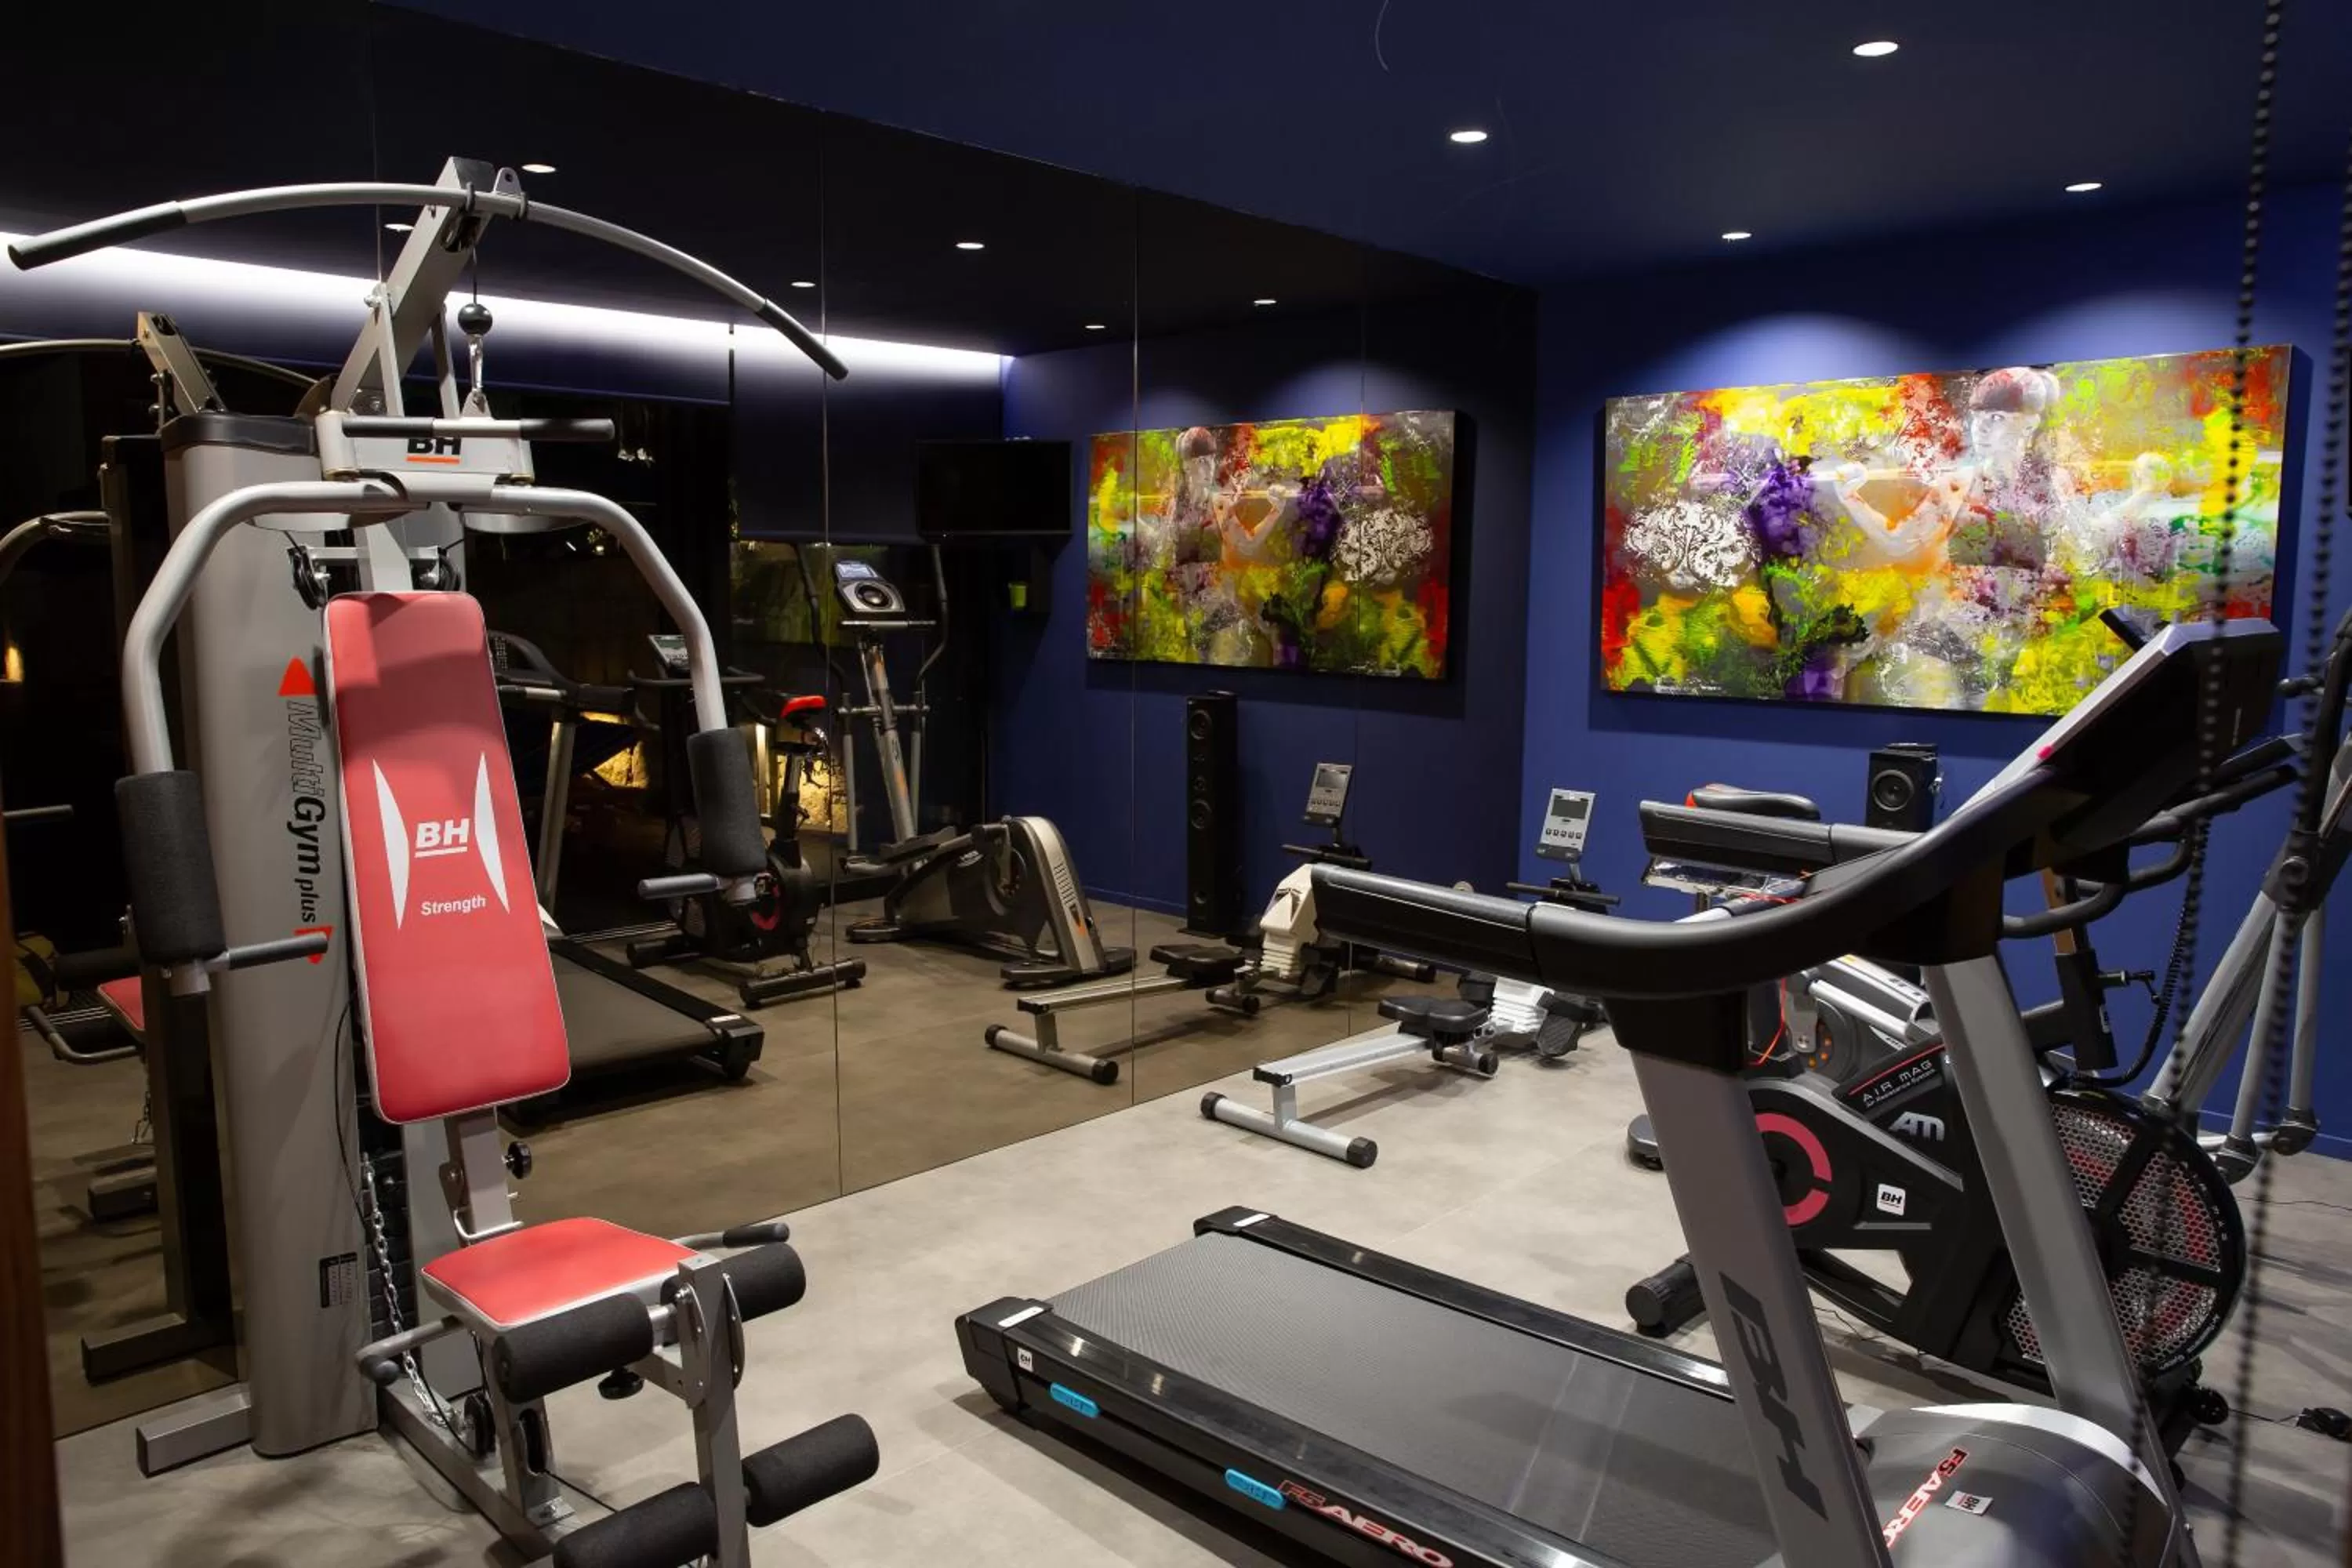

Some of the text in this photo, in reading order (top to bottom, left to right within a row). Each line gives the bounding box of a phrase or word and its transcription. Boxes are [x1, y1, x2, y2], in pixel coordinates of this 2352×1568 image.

[416, 818, 470, 848] BH
[294, 877, 320, 924] plus
[420, 894, 487, 916] Strength
[1863, 1080, 1893, 1103] AIR
[1881, 1191, 1903, 1205] BH
[1718, 1270, 1829, 1523] BH
[1961, 1494, 1980, 1511] BH
